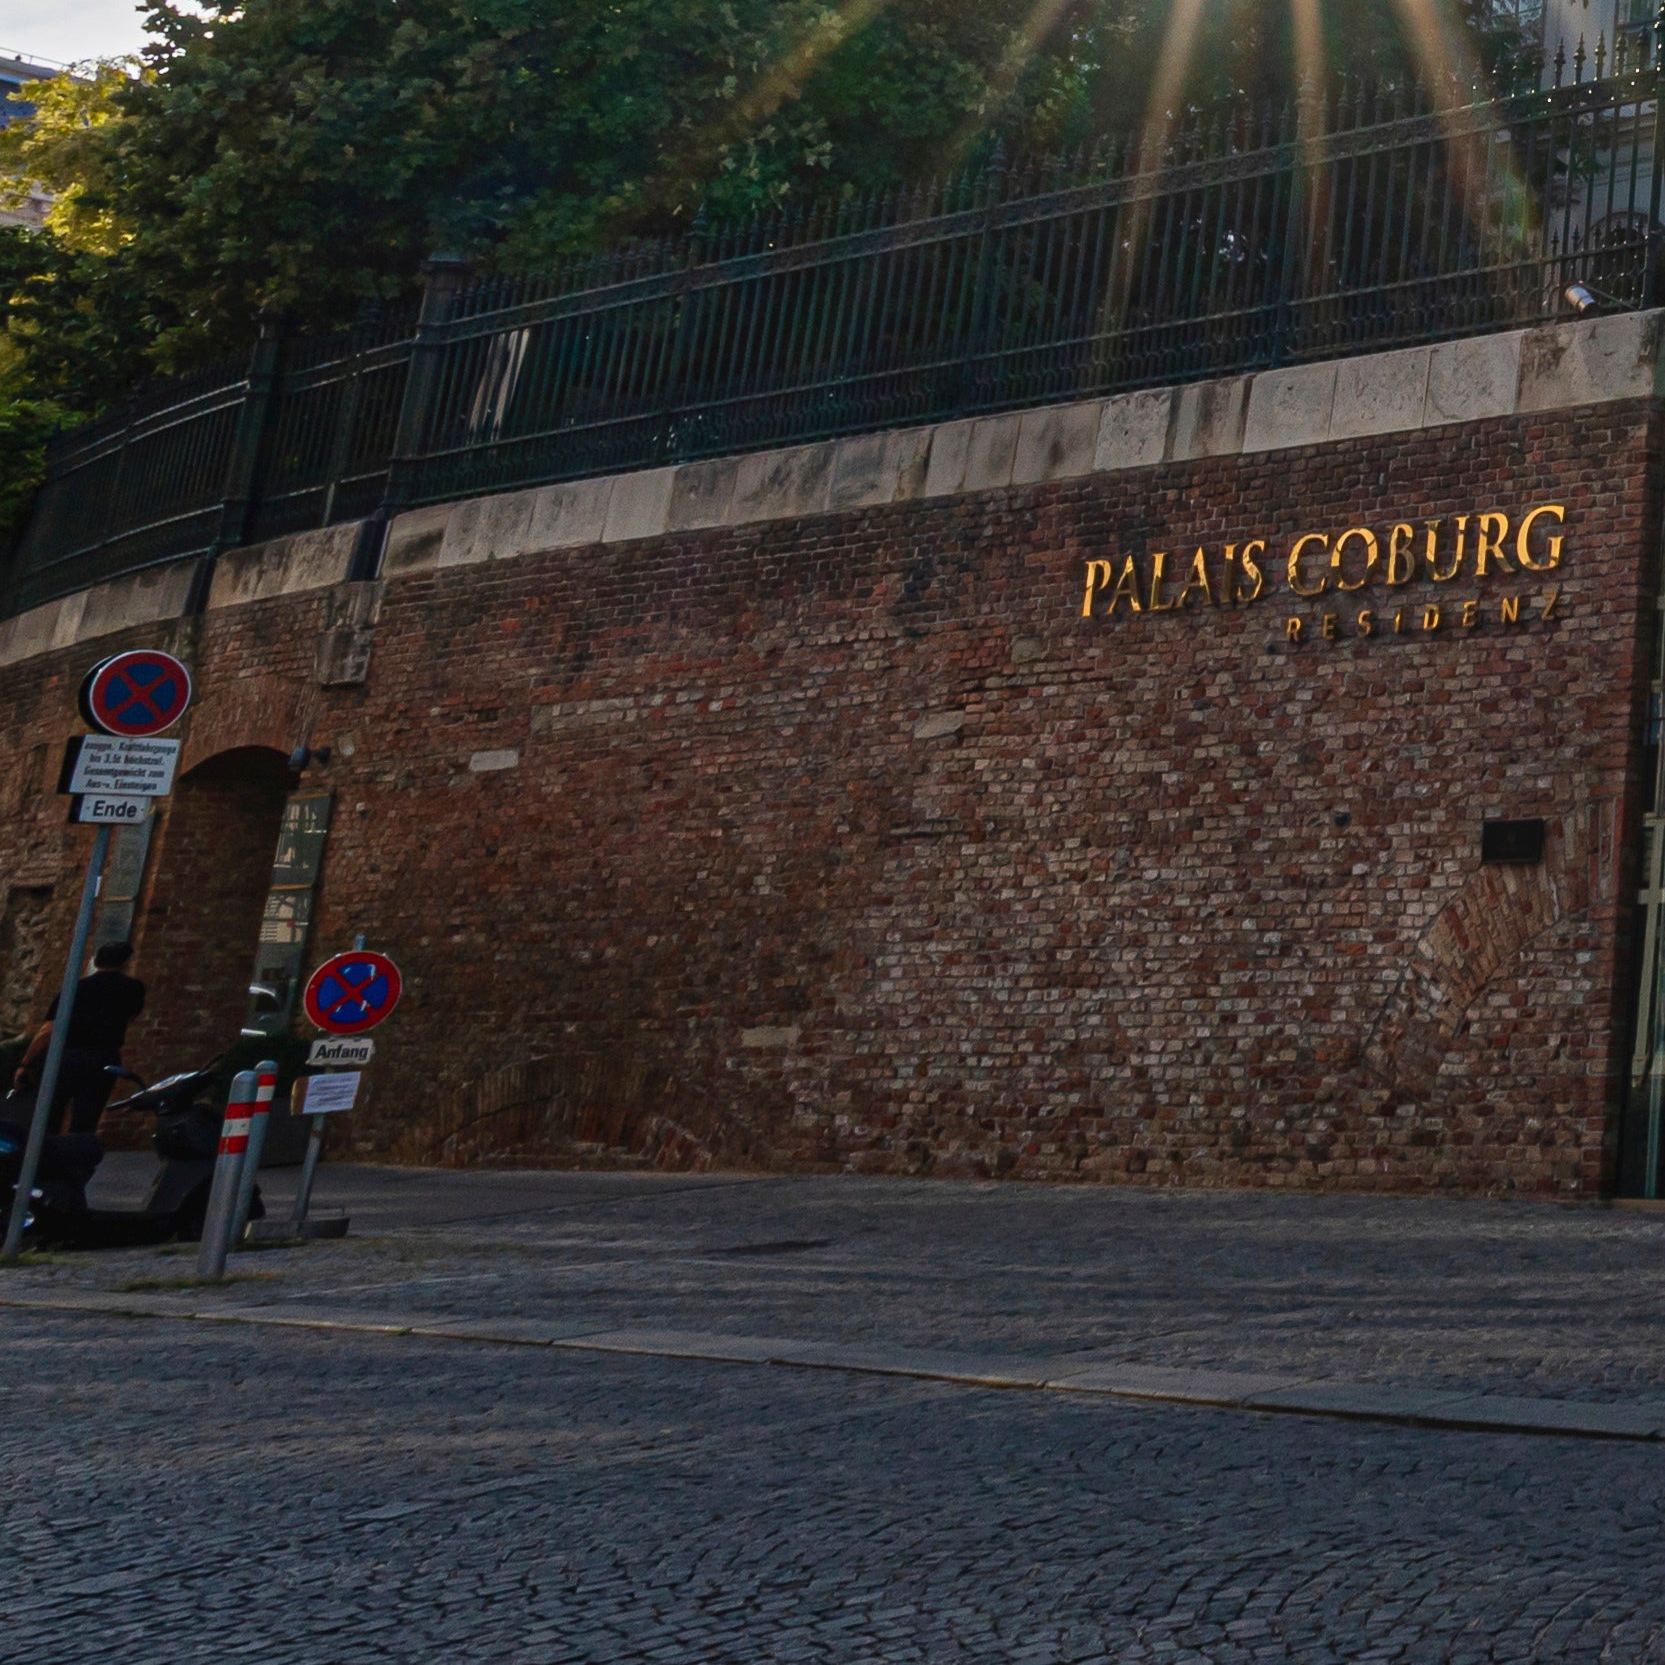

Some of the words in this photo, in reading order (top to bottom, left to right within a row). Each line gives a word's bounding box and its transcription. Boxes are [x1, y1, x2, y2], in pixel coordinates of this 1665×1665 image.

[1080, 539, 1266, 618] PALAIS
[1286, 504, 1566, 596] COBURG
[1286, 592, 1561, 642] RESIDENZ
[92, 800, 138, 818] Ende
[315, 1044, 370, 1061] Anfang
